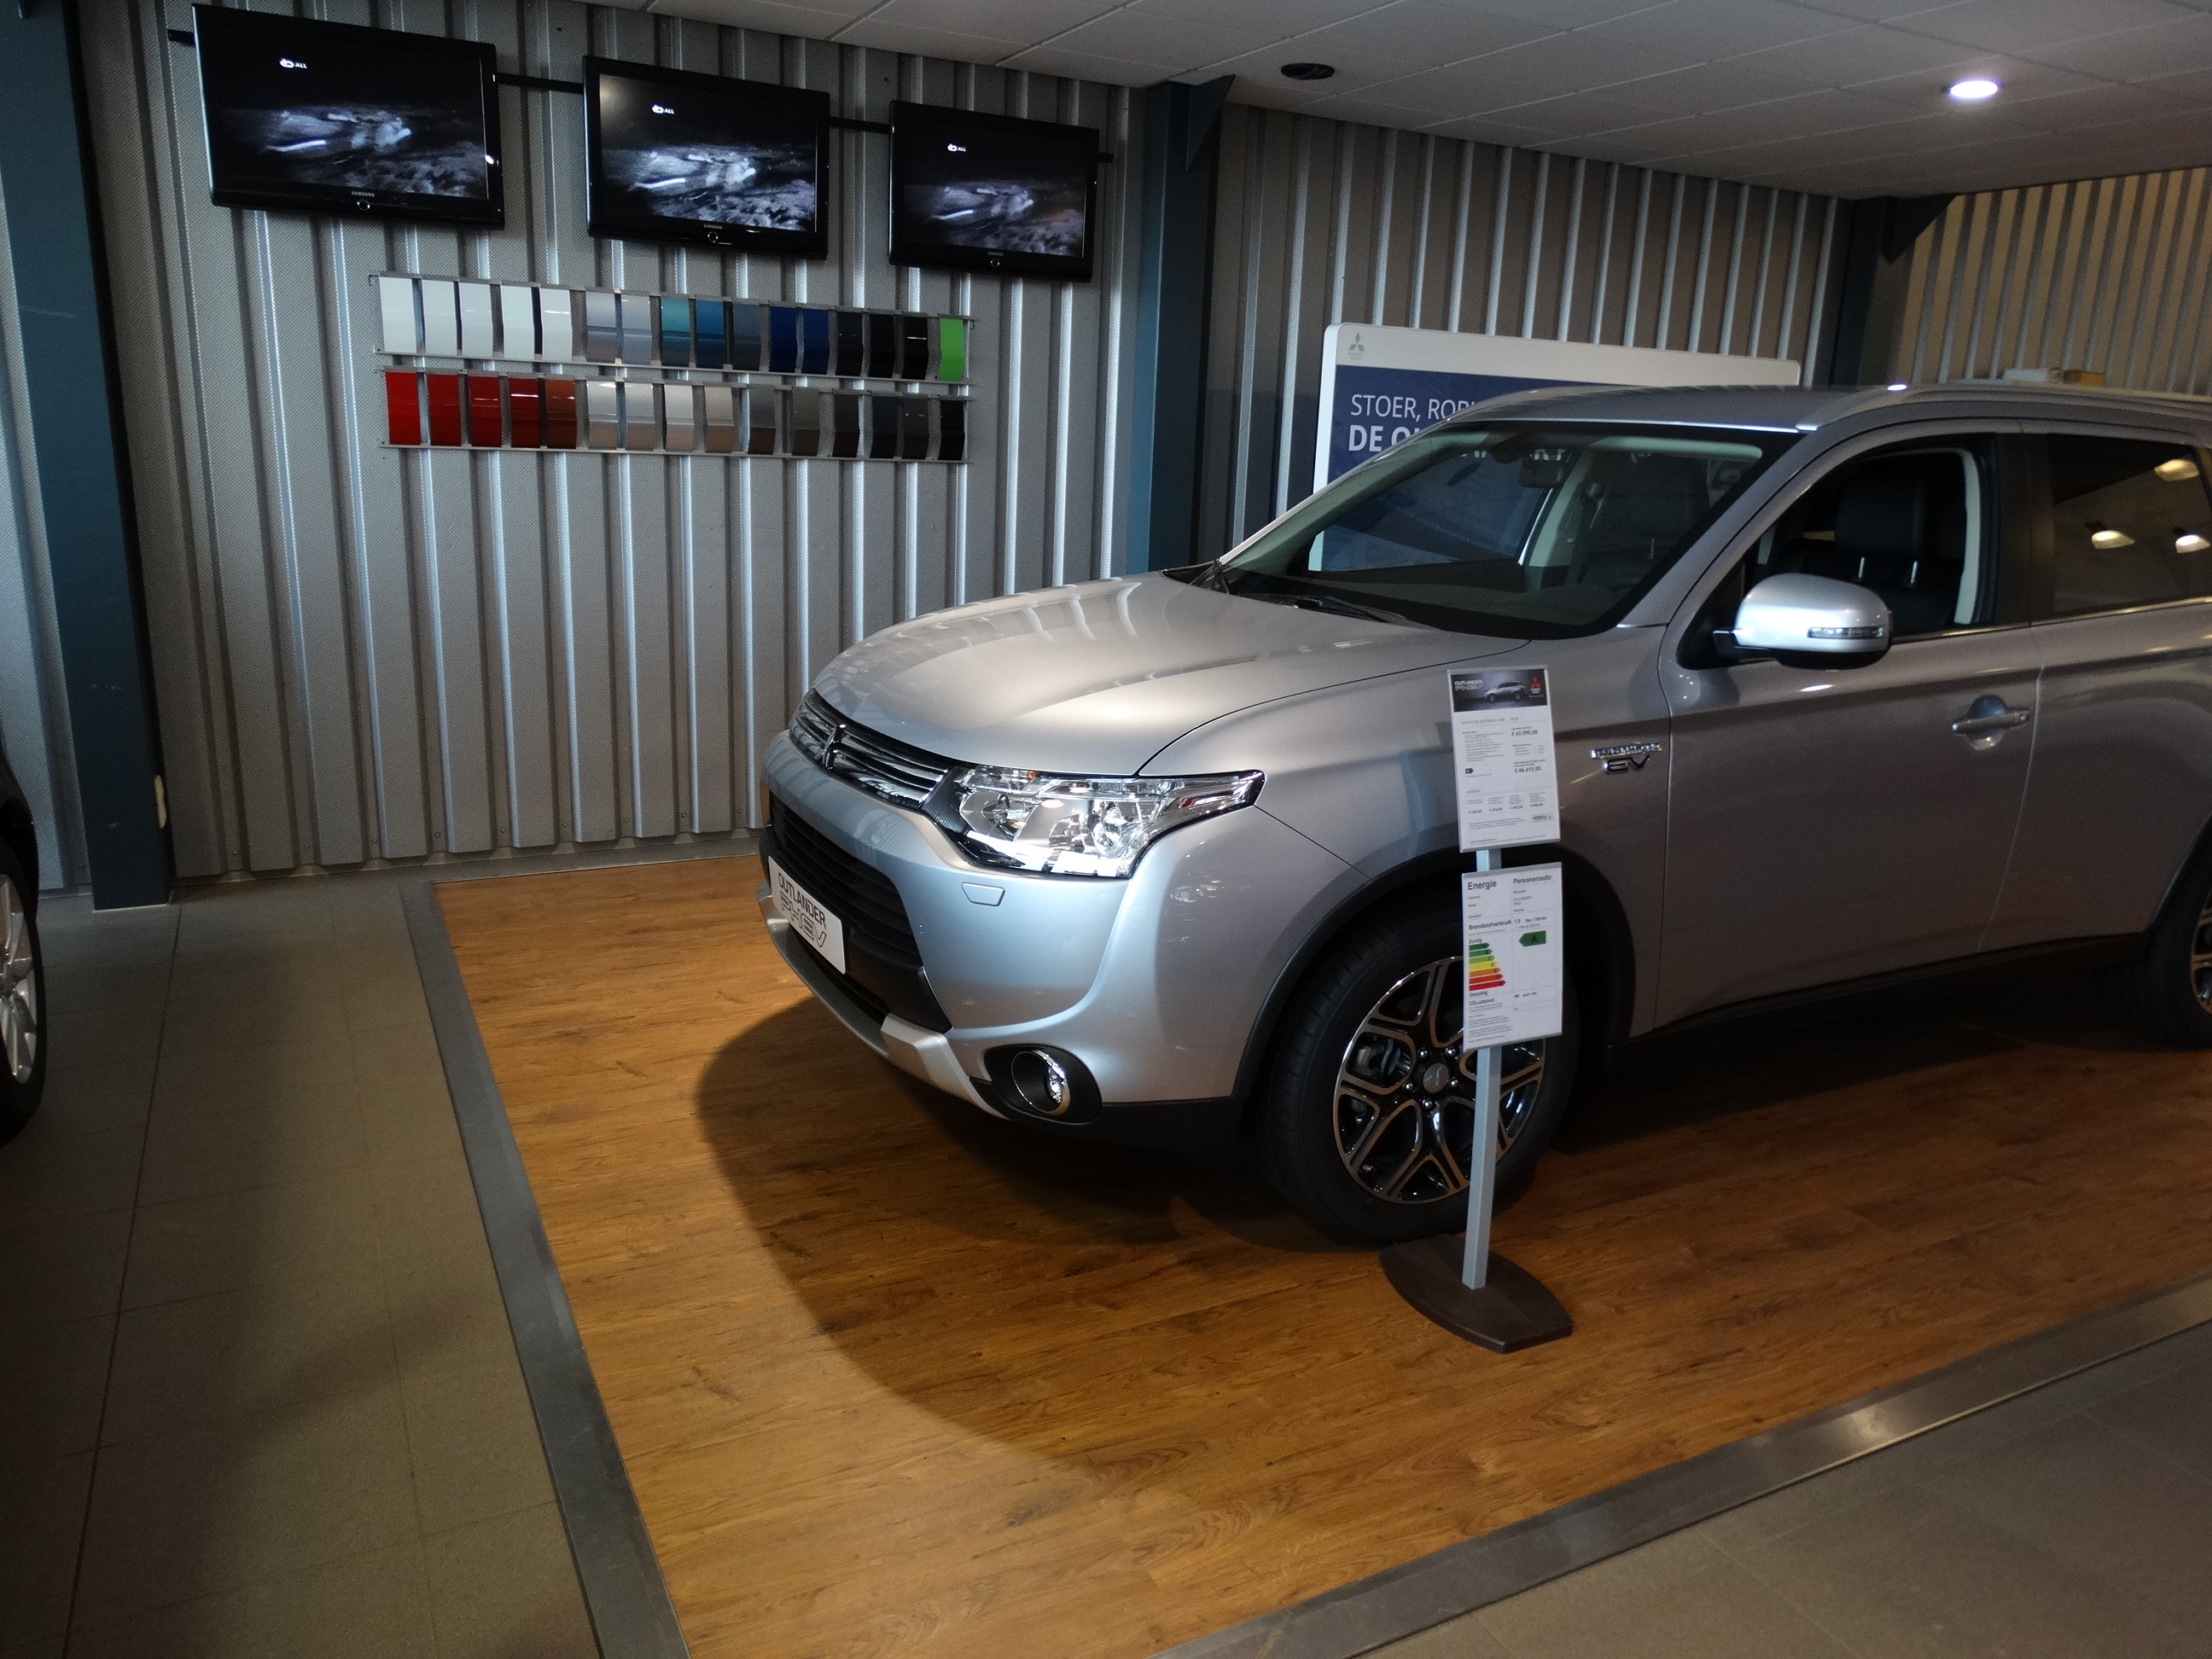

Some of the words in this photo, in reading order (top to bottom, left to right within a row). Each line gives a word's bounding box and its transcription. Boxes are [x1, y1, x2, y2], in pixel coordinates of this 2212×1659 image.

[1351, 393, 1421, 422] STOER,
[1348, 424, 1383, 452] DE
[1468, 879, 1497, 890] Energie
[1513, 875, 1551, 885] Personenauto
[778, 872, 827, 929] OUTLANDER
[780, 891, 827, 948] PHEV
[1469, 919, 1511, 930] Brandstofverbruik
[1531, 934, 1537, 943] A
